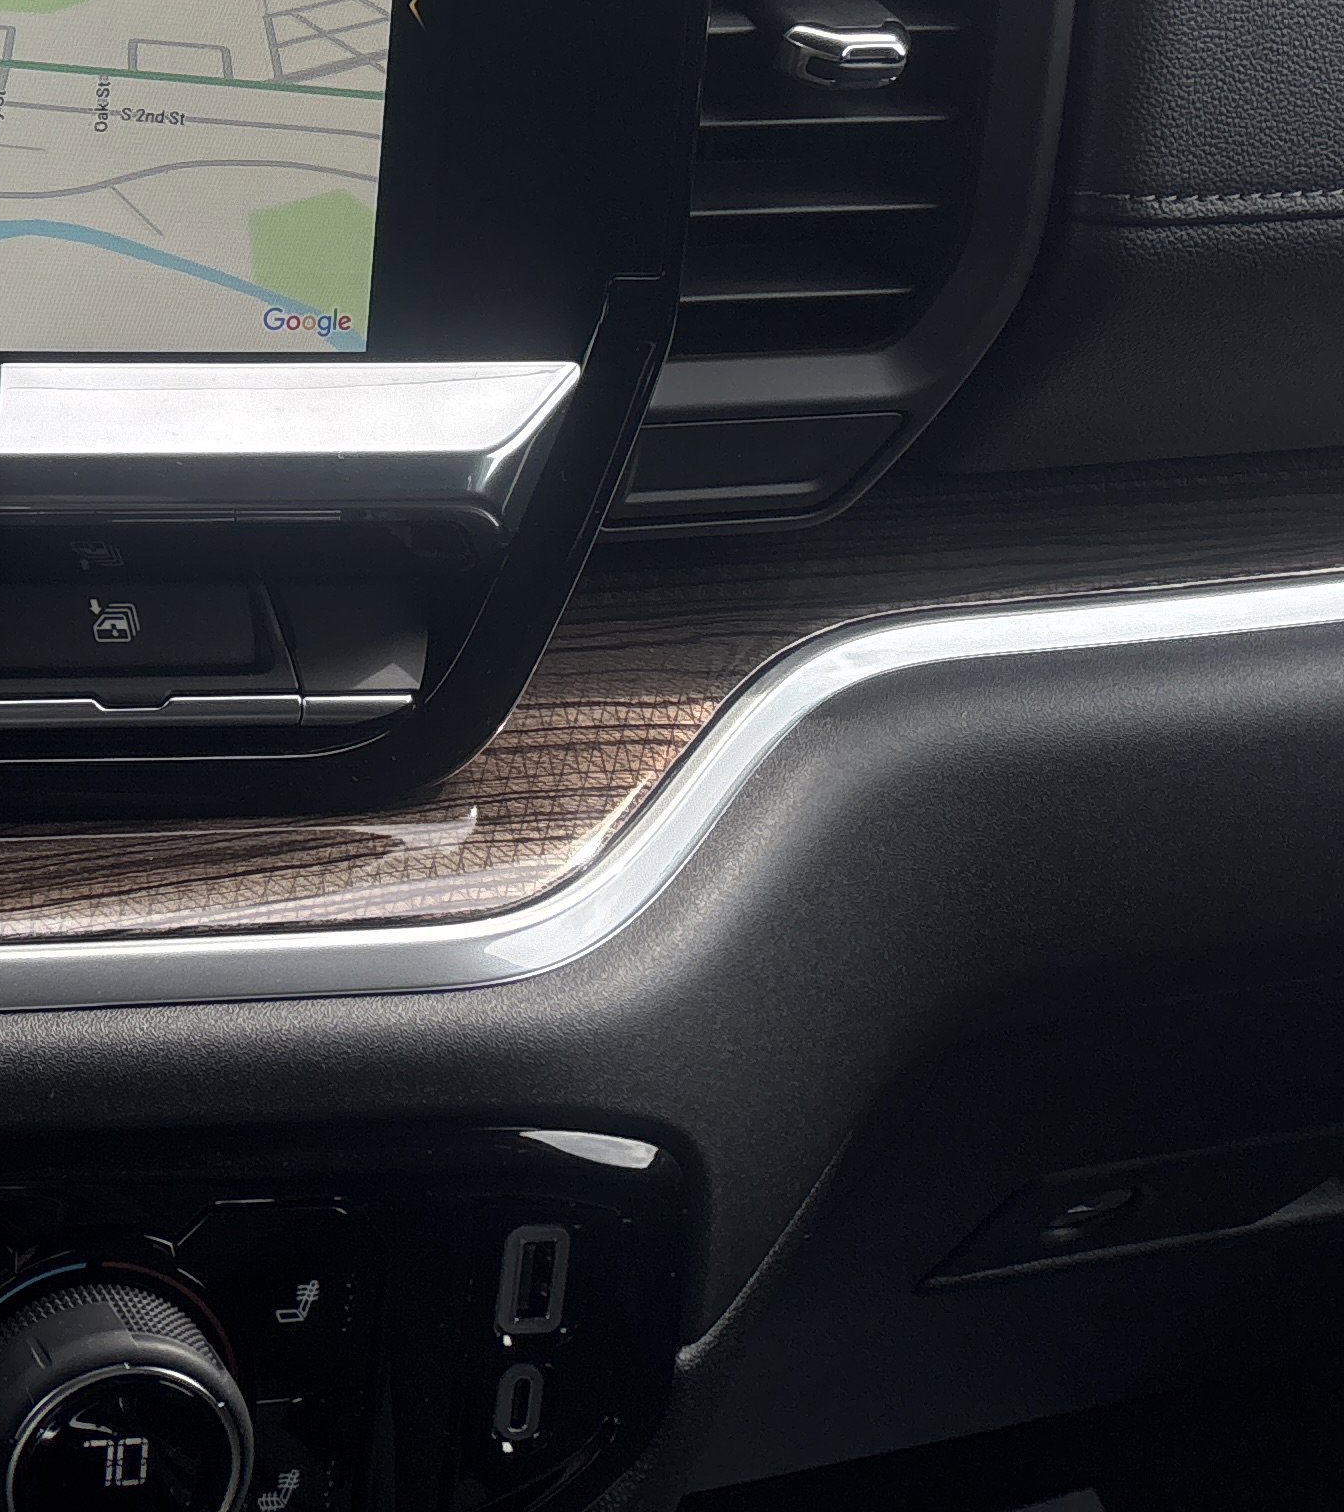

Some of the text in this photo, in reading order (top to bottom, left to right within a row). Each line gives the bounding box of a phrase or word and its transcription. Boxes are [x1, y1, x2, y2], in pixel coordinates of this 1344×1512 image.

[94, 80, 111, 133] Oak St
[120, 107, 186, 126] S 2nd St
[263, 308, 352, 337] Google
[83, 1436, 150, 1487] 70
